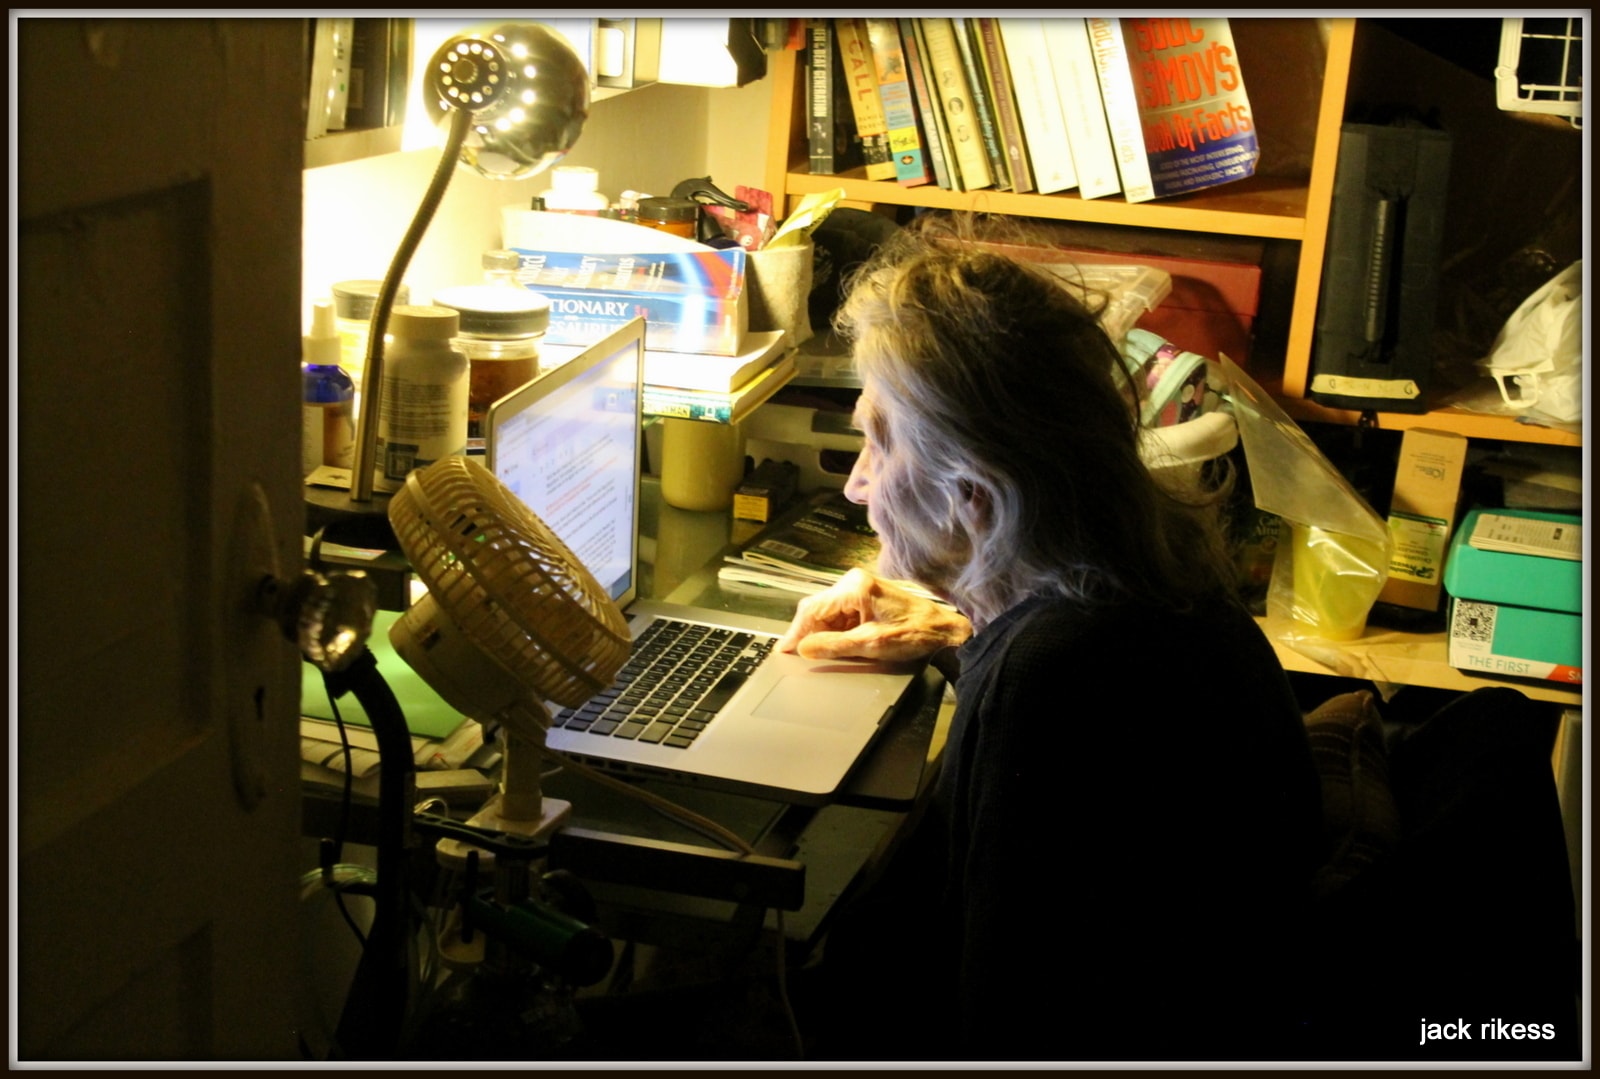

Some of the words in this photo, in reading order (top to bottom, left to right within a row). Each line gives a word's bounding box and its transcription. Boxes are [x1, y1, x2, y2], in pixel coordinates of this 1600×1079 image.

[813, 49, 827, 67] BEAT
[849, 39, 872, 101] CALL
[1138, 41, 1240, 109] SIMOV'S
[812, 70, 827, 117] GENERATION
[1193, 102, 1252, 143] Facts
[549, 298, 630, 317] TIONARY
[1468, 654, 1494, 669] THE
[1495, 658, 1531, 675] FIRST
